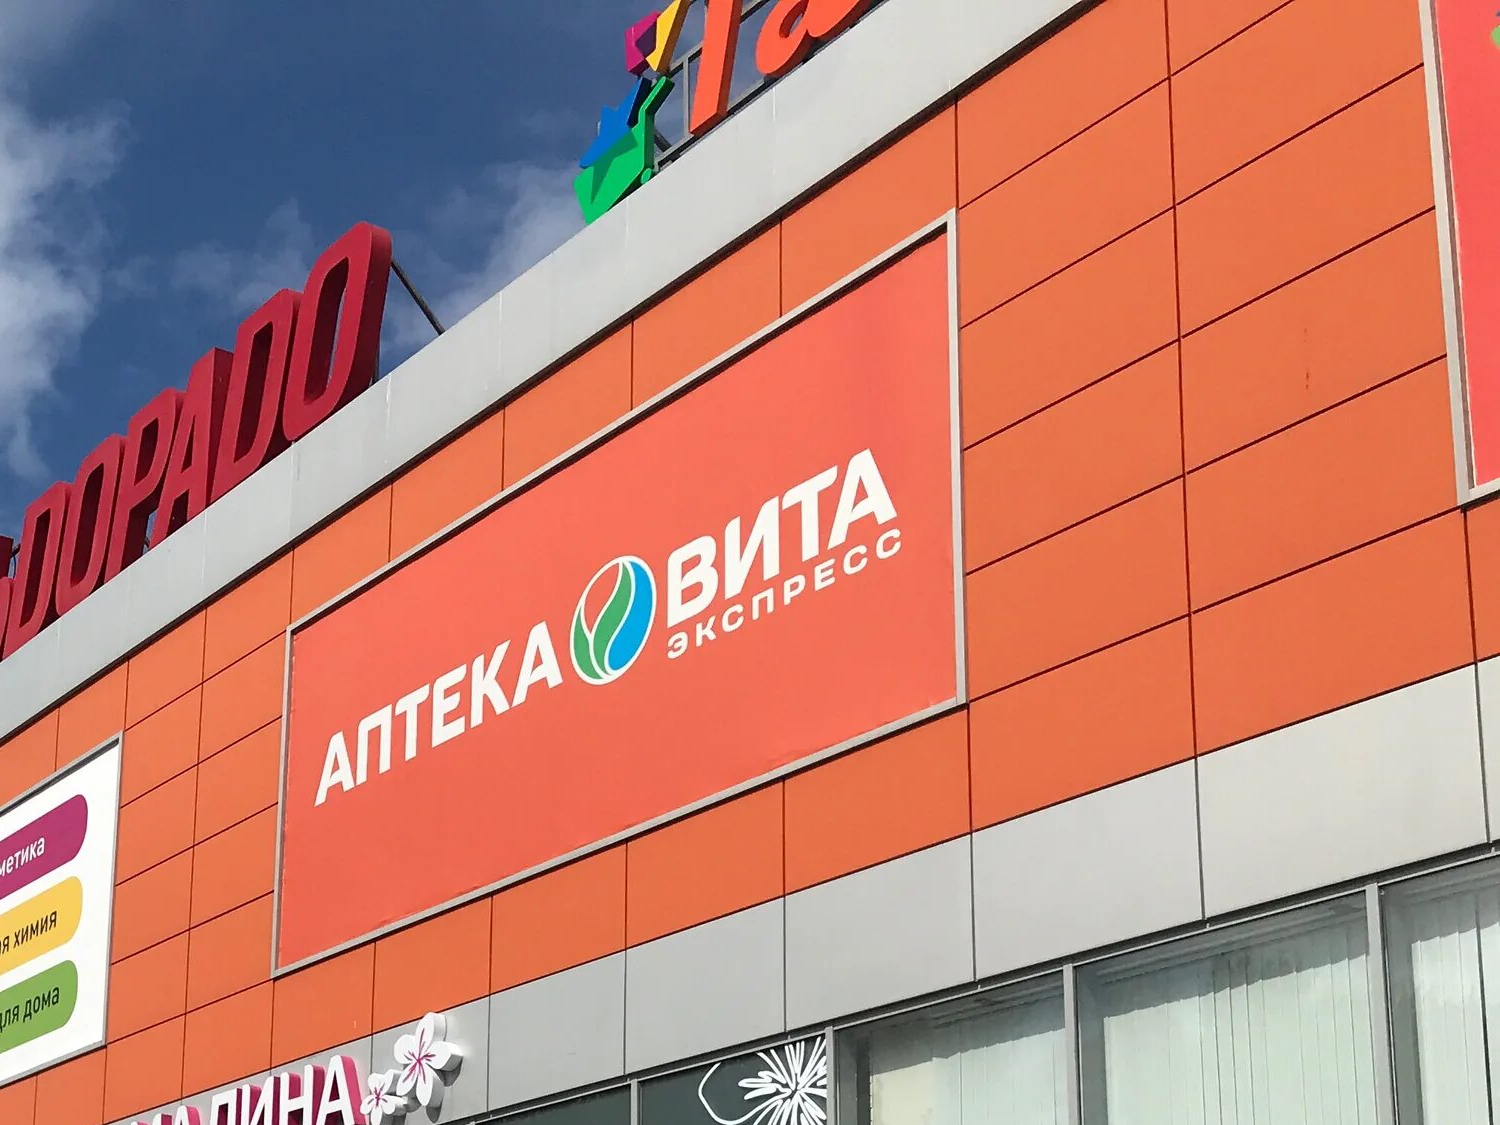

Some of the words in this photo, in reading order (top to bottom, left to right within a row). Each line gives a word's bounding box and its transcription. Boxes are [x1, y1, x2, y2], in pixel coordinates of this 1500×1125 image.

[666, 447, 898, 628] ВИТА
[666, 528, 903, 661] ЭКСПРЕСС
[314, 621, 563, 808] АПТЕКА
[13, 909, 58, 947] химия
[23, 985, 60, 1020] дома
